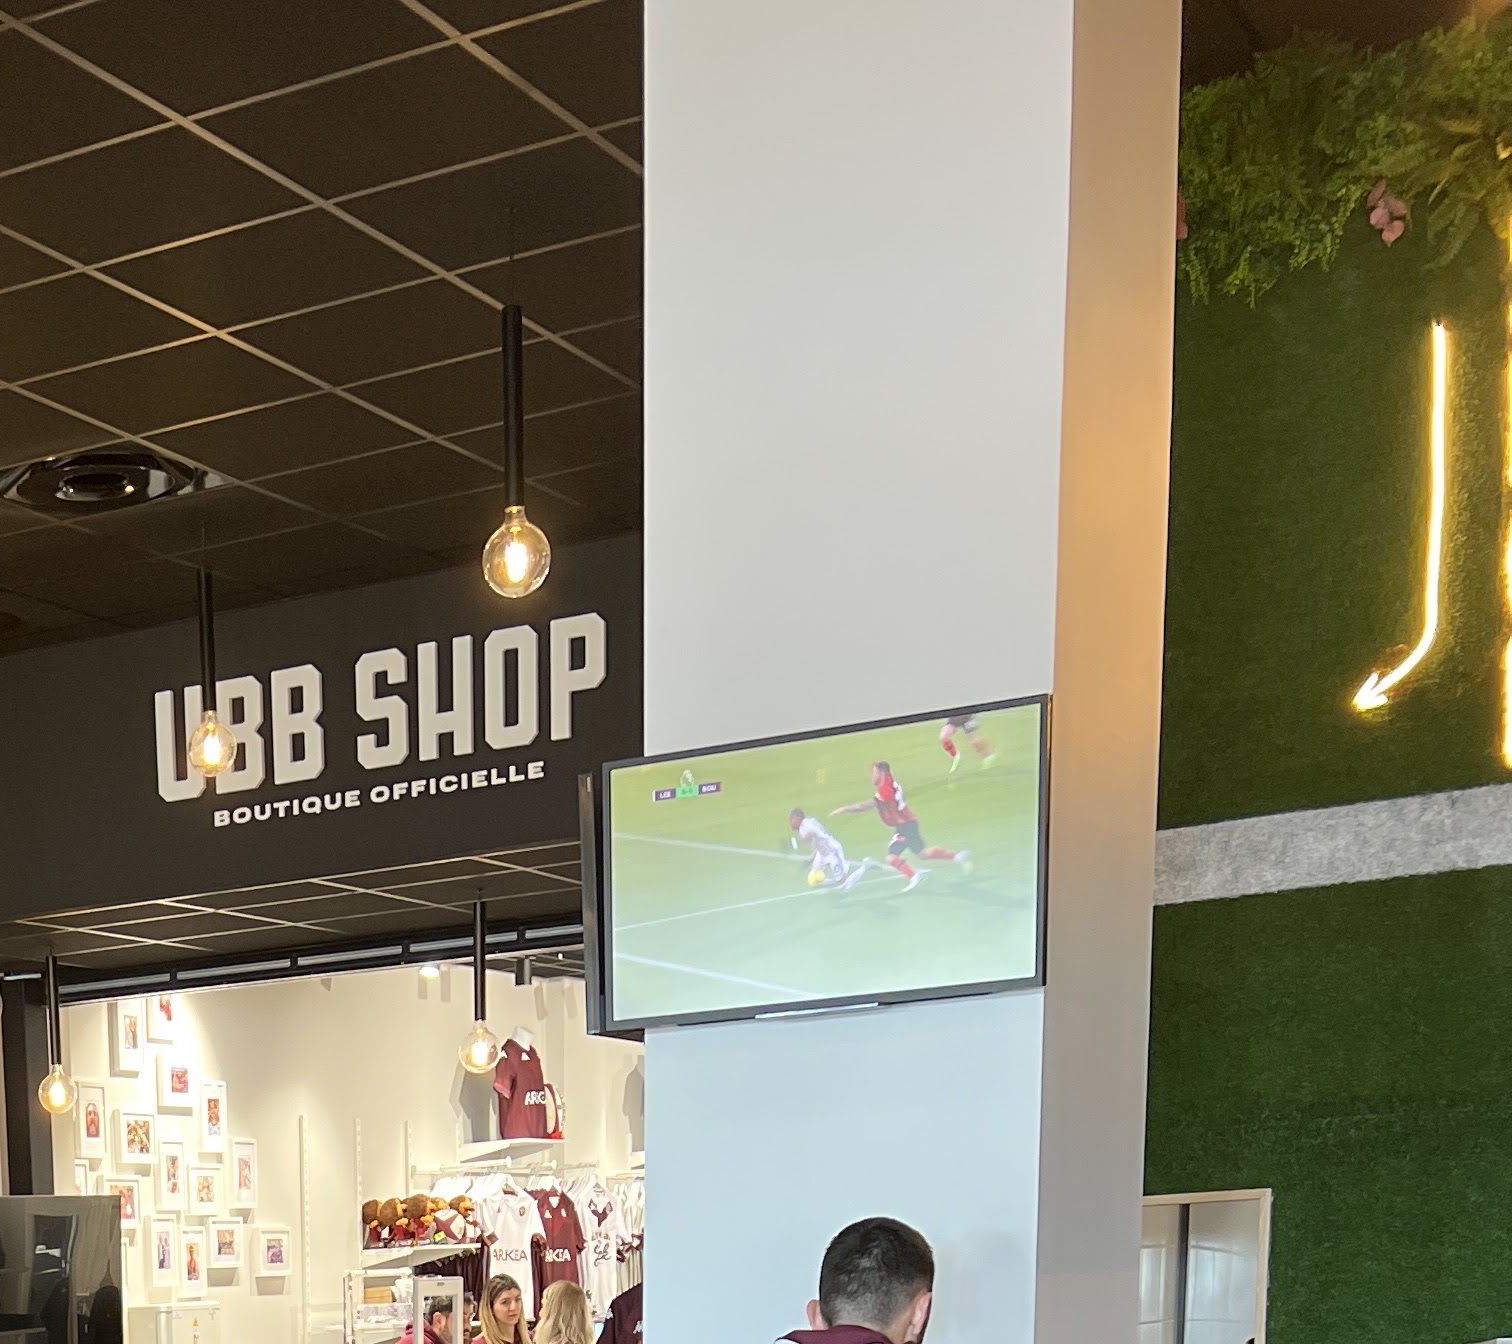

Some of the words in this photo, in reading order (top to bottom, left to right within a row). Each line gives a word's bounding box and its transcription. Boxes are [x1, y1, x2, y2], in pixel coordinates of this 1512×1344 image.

[154, 663, 324, 803] UBB
[355, 612, 607, 770] SHOP
[214, 789, 361, 828] BOUTIQUE
[369, 760, 545, 804] OFFICIELLE
[492, 1248, 528, 1262] ARKEA
